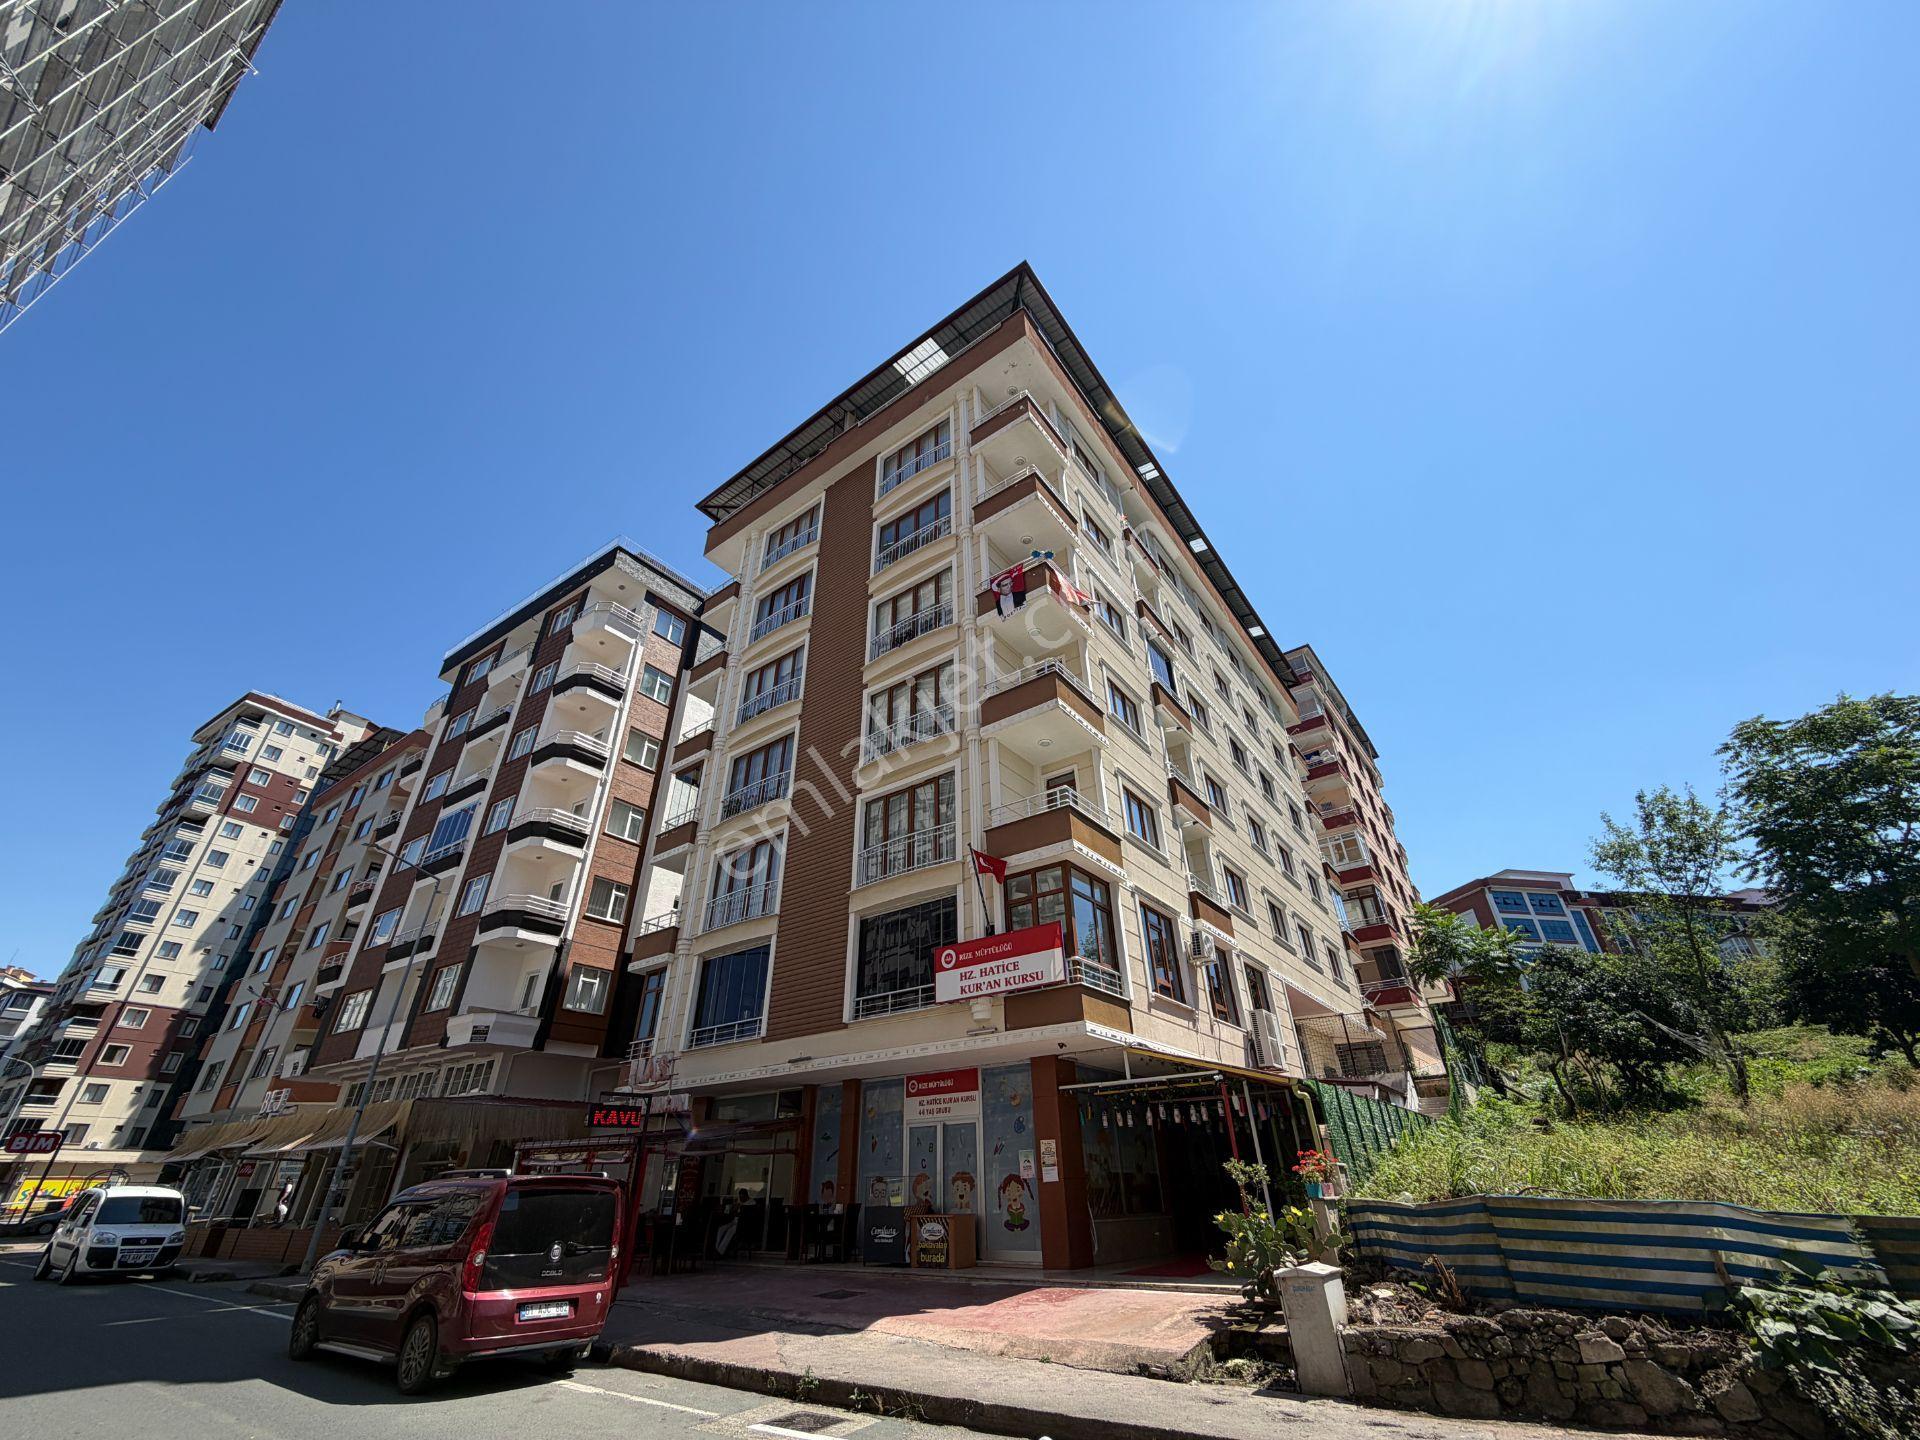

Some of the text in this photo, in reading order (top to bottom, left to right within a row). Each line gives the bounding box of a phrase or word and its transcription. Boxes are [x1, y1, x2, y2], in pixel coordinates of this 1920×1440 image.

[960, 961, 1020, 981] HZ. HATİCE
[960, 971, 1044, 995] KUR'AN KURSU
[920, 1252, 945, 1263] burada
